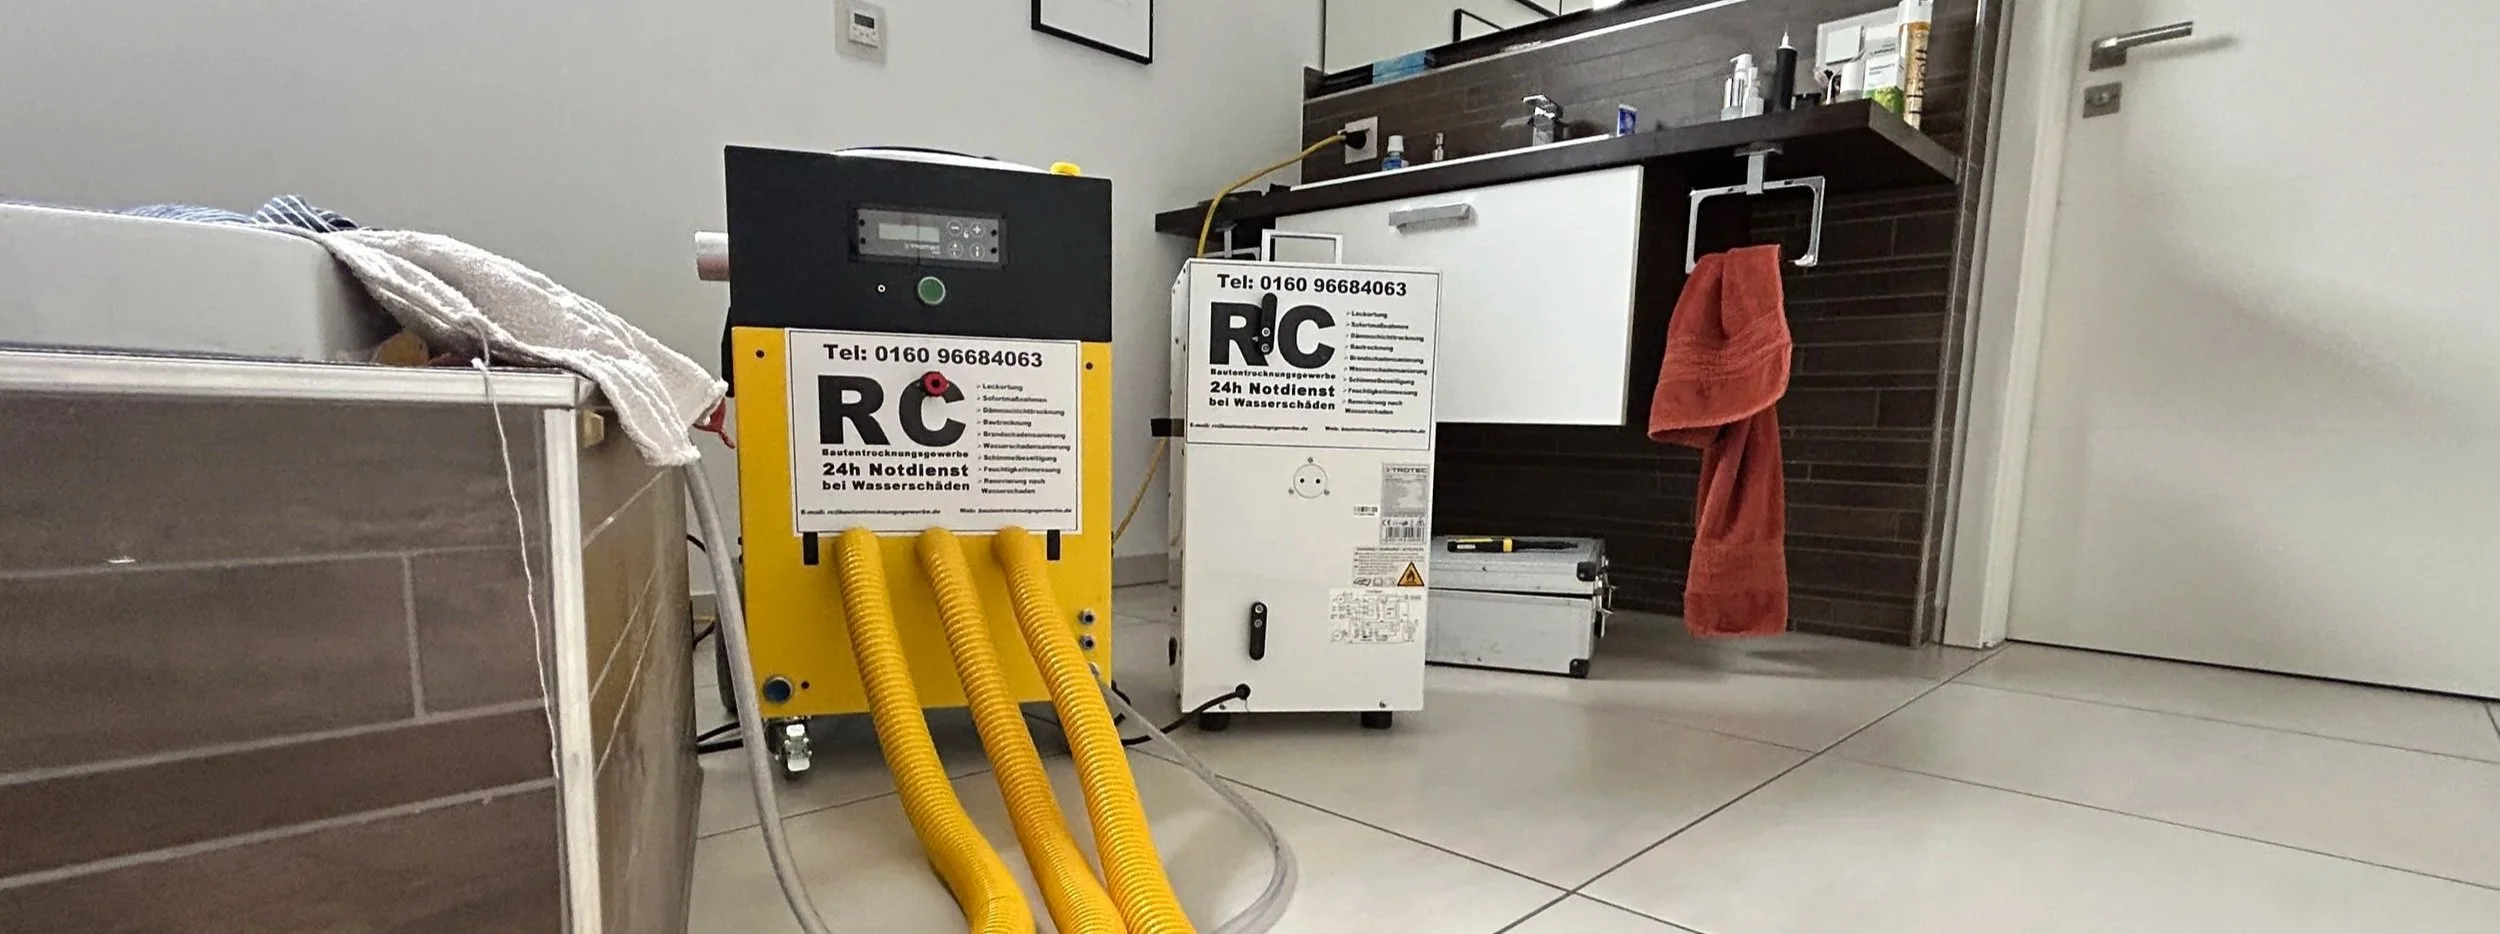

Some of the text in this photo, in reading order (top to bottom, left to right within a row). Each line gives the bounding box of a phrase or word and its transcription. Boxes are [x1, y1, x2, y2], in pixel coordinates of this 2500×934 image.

[1217, 274, 1407, 296] Tel: 0160 96684063
[1209, 301, 1336, 369] RC
[823, 343, 1043, 367] Tel: 0160 96684063
[1210, 368, 1336, 380] Bautentrocknungsgewerbe
[1210, 381, 1335, 397] 24h Notdienst
[817, 374, 967, 447] RC
[1209, 397, 1335, 410] bei Wasserschäden
[822, 448, 969, 459] Bautentrocknungsgewerbe
[822, 463, 969, 478] 24h Notdienst
[822, 480, 970, 492] bei Wasserschäden
